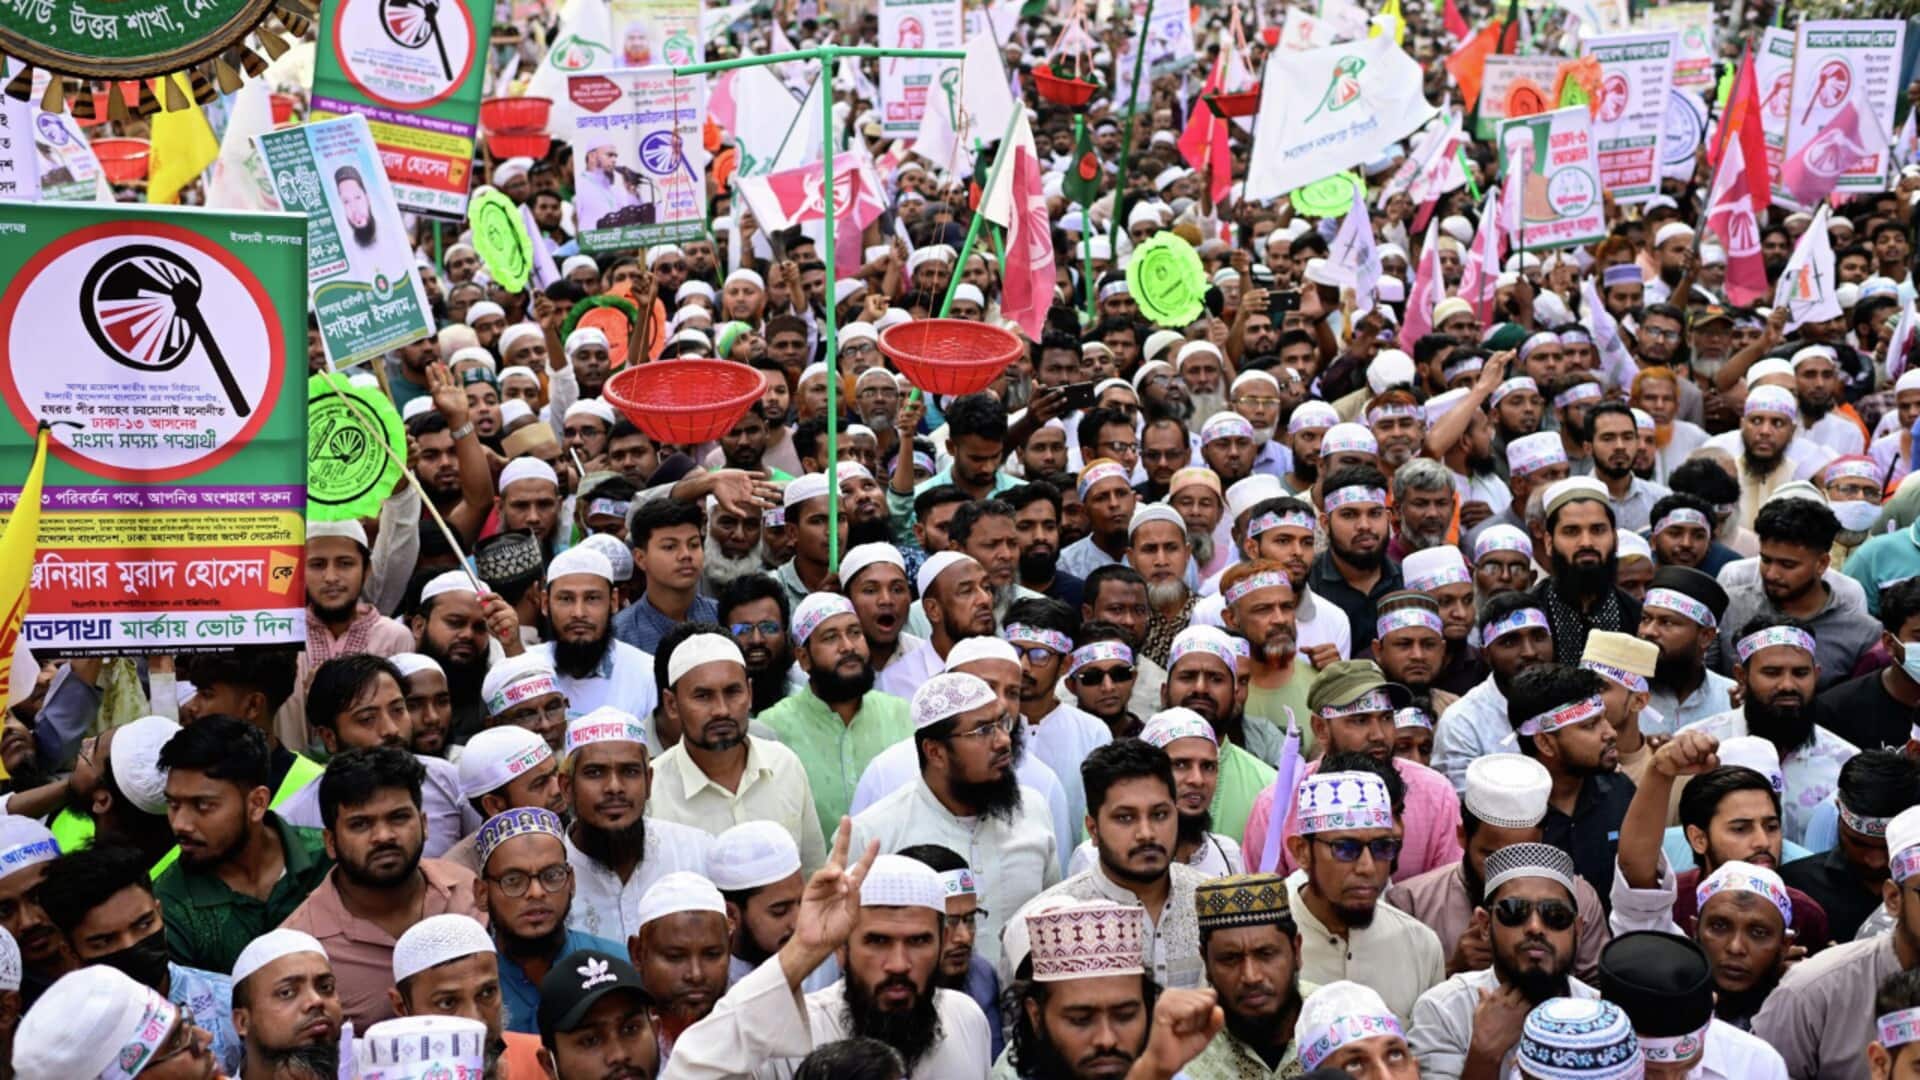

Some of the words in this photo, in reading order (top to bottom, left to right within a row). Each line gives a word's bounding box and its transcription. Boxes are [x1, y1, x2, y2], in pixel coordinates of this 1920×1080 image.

[70, 3, 118, 39] উত্তর
[125, 5, 184, 38] শাখা,
[98, 405, 129, 416] সাহেব
[92, 417, 145, 430] ঢাকা-১৩
[150, 418, 197, 430] আসনের
[72, 433, 113, 448] সংসদ
[119, 434, 159, 448] সদস্য
[56, 488, 108, 504] পরিবর্তন
[112, 492, 143, 507] পথে,
[147, 489, 198, 504] আপনিও
[200, 491, 256, 505] অংশগ্রহণ
[260, 491, 292, 504] করুন
[116, 559, 177, 595] মুরাদ
[185, 557, 265, 590] হোসেন
[272, 564, 294, 580] কে
[120, 614, 188, 640] মার্কায়
[196, 613, 247, 638] ভোট
[255, 612, 295, 637] দিন
[505, 677, 552, 701] আন্দোলন
[573, 722, 624, 744] আন্দোলন
